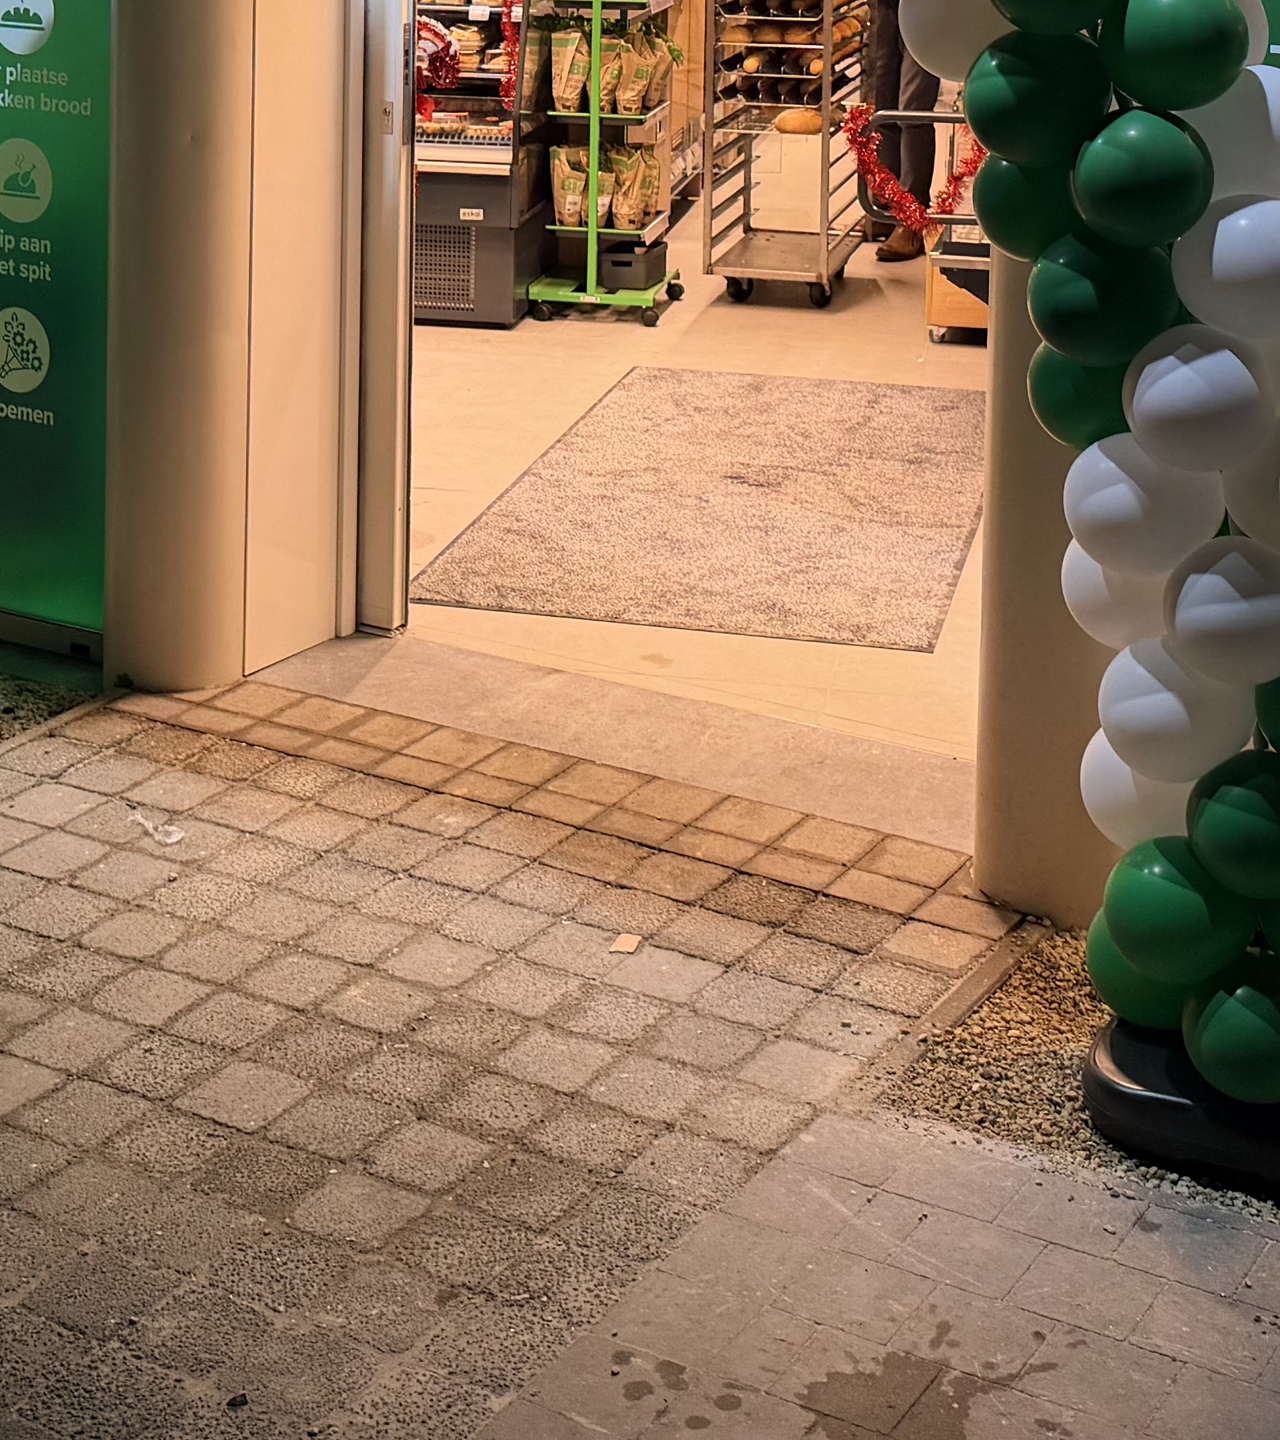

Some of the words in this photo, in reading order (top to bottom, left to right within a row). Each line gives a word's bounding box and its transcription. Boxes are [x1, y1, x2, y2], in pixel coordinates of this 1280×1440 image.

[5, 62, 69, 86] plaatse
[40, 92, 92, 116] brood
[19, 236, 52, 254] aan
[19, 261, 52, 282] spit
